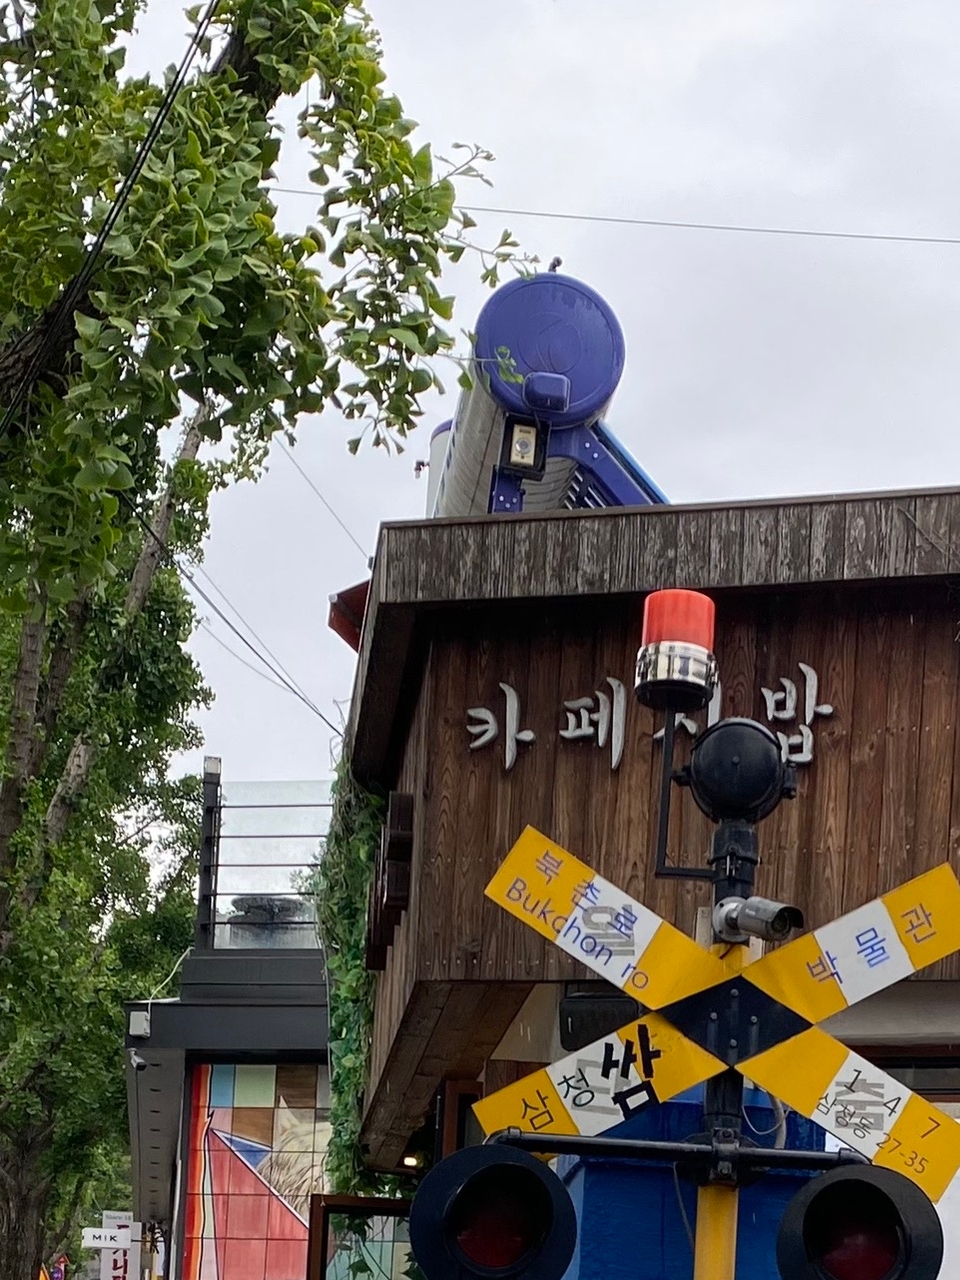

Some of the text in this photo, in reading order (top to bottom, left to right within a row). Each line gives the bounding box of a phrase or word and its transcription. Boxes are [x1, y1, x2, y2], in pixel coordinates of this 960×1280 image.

[467, 677, 627, 771] 카페
[505, 877, 614, 967] Bukchon
[621, 962, 650, 990] ro
[535, 849, 639, 940] 북촌로
[807, 903, 937, 984] 박물관
[521, 1067, 596, 1131] 삼청
[815, 1093, 875, 1140] 삼청동
[875, 1132, 930, 1174] 27-35
